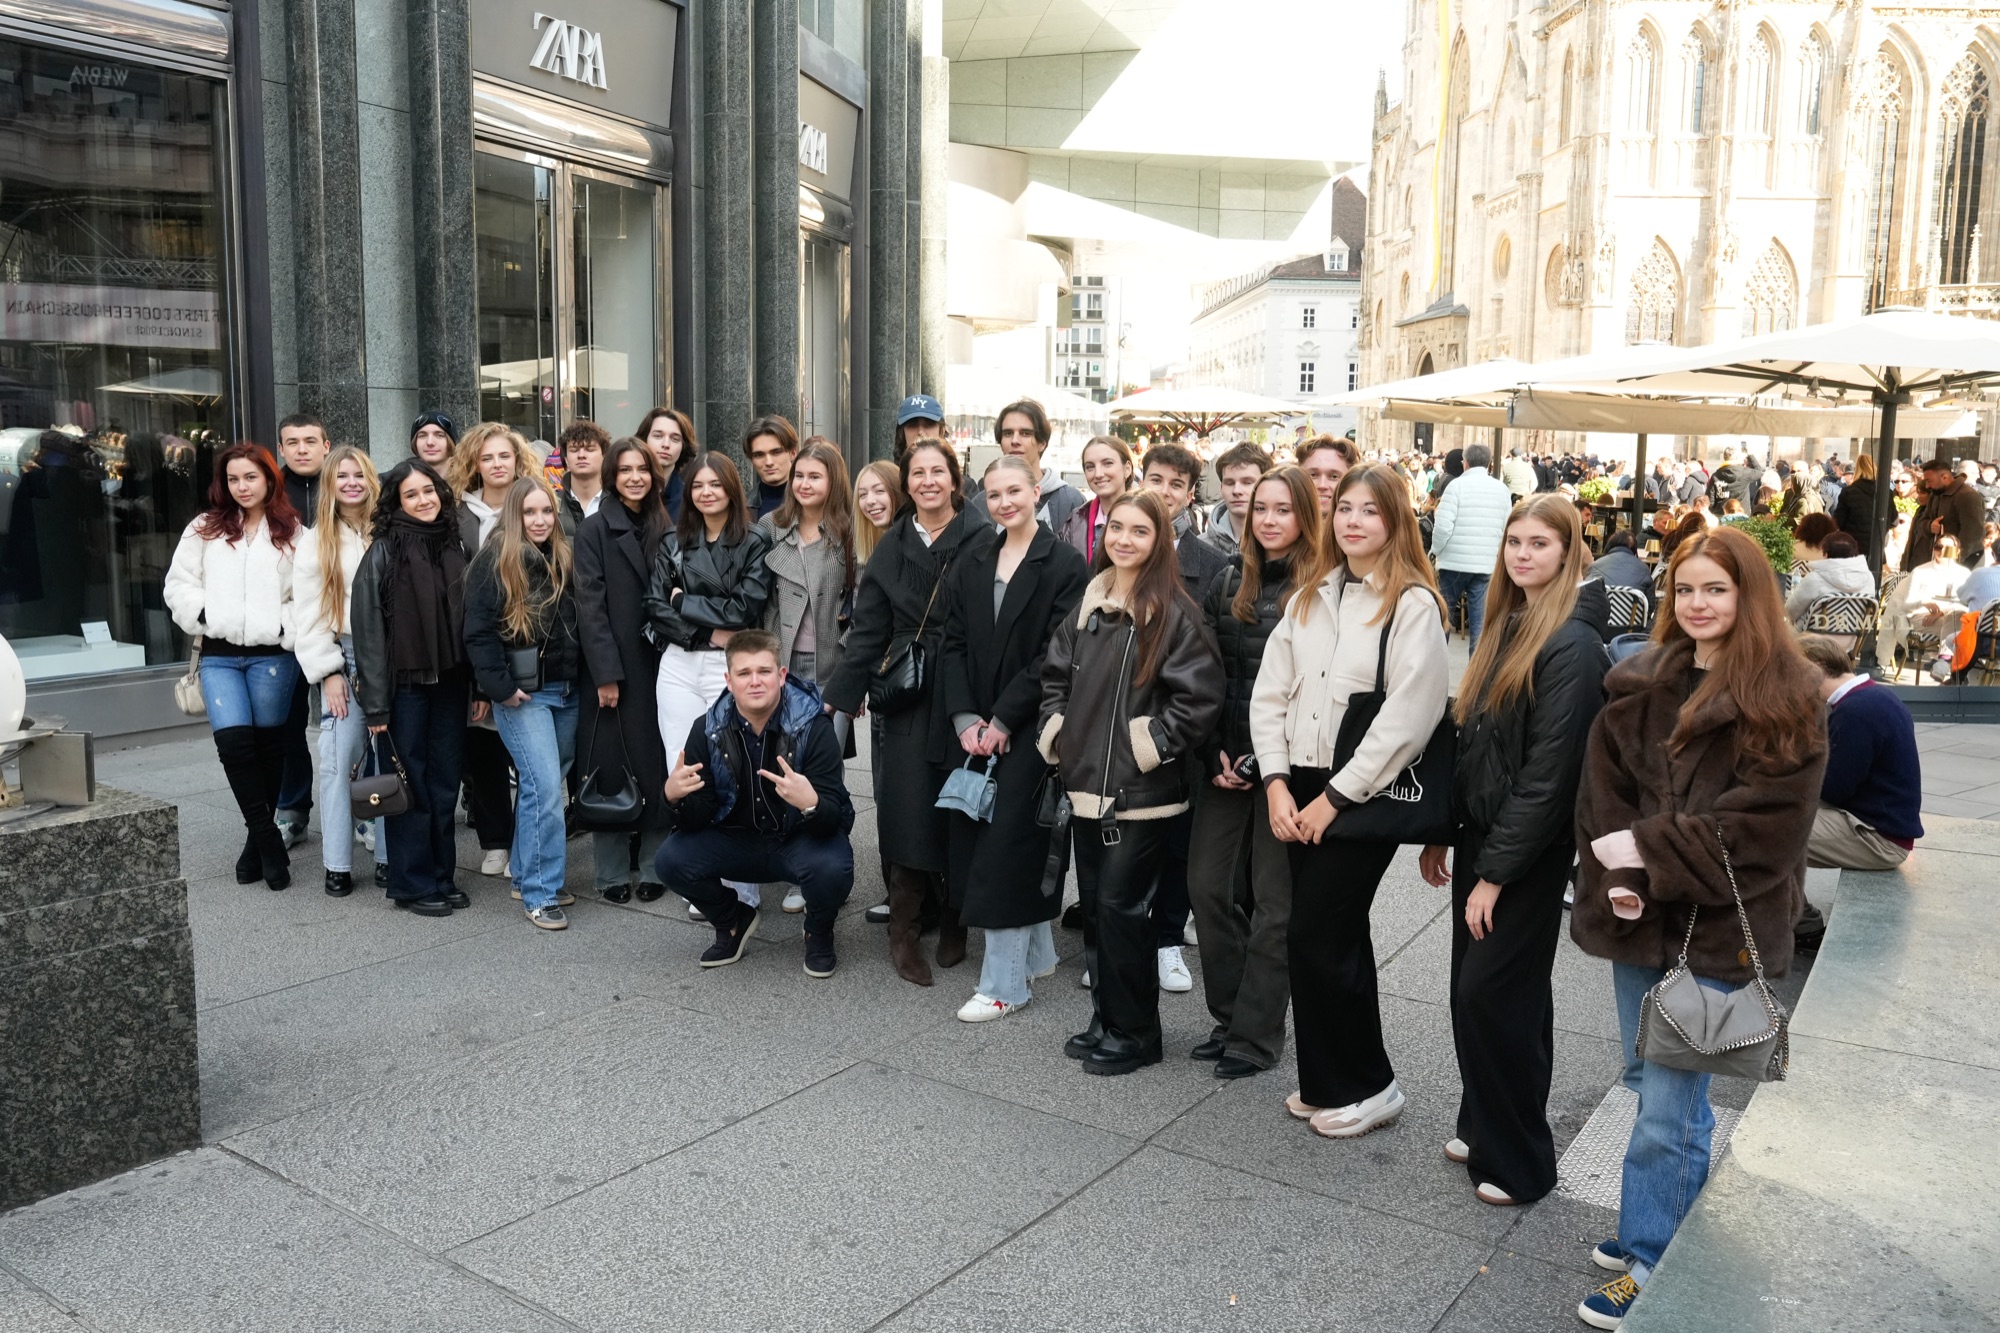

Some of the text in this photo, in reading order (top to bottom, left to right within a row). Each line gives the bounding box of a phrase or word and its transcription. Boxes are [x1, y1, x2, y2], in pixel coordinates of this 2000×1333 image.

[529, 11, 611, 91] ZARA
[911, 397, 928, 409] NY
[1812, 613, 1914, 631] DEMEL
